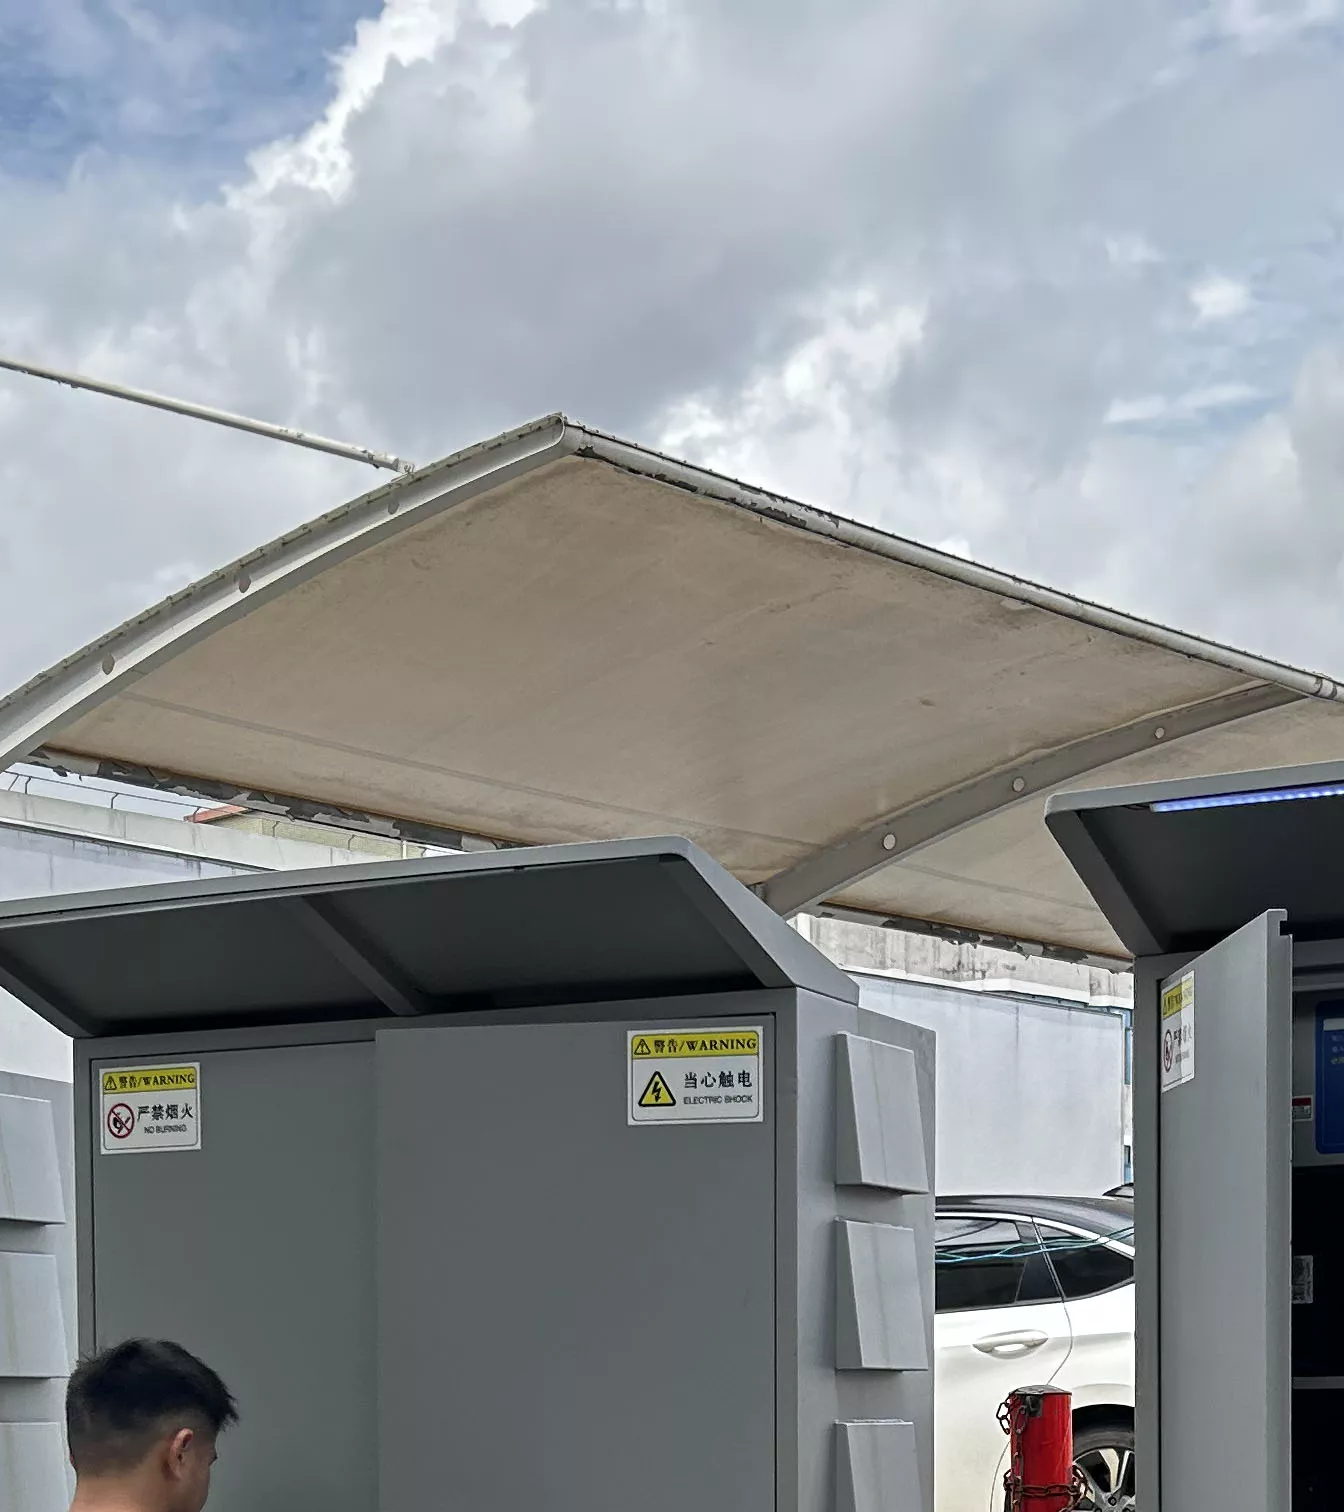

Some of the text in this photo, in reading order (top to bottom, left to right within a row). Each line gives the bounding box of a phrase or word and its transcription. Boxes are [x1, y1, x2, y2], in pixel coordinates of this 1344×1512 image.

[684, 1070, 753, 1089] 当心触电
[137, 1103, 193, 1121] 严禁烟火
